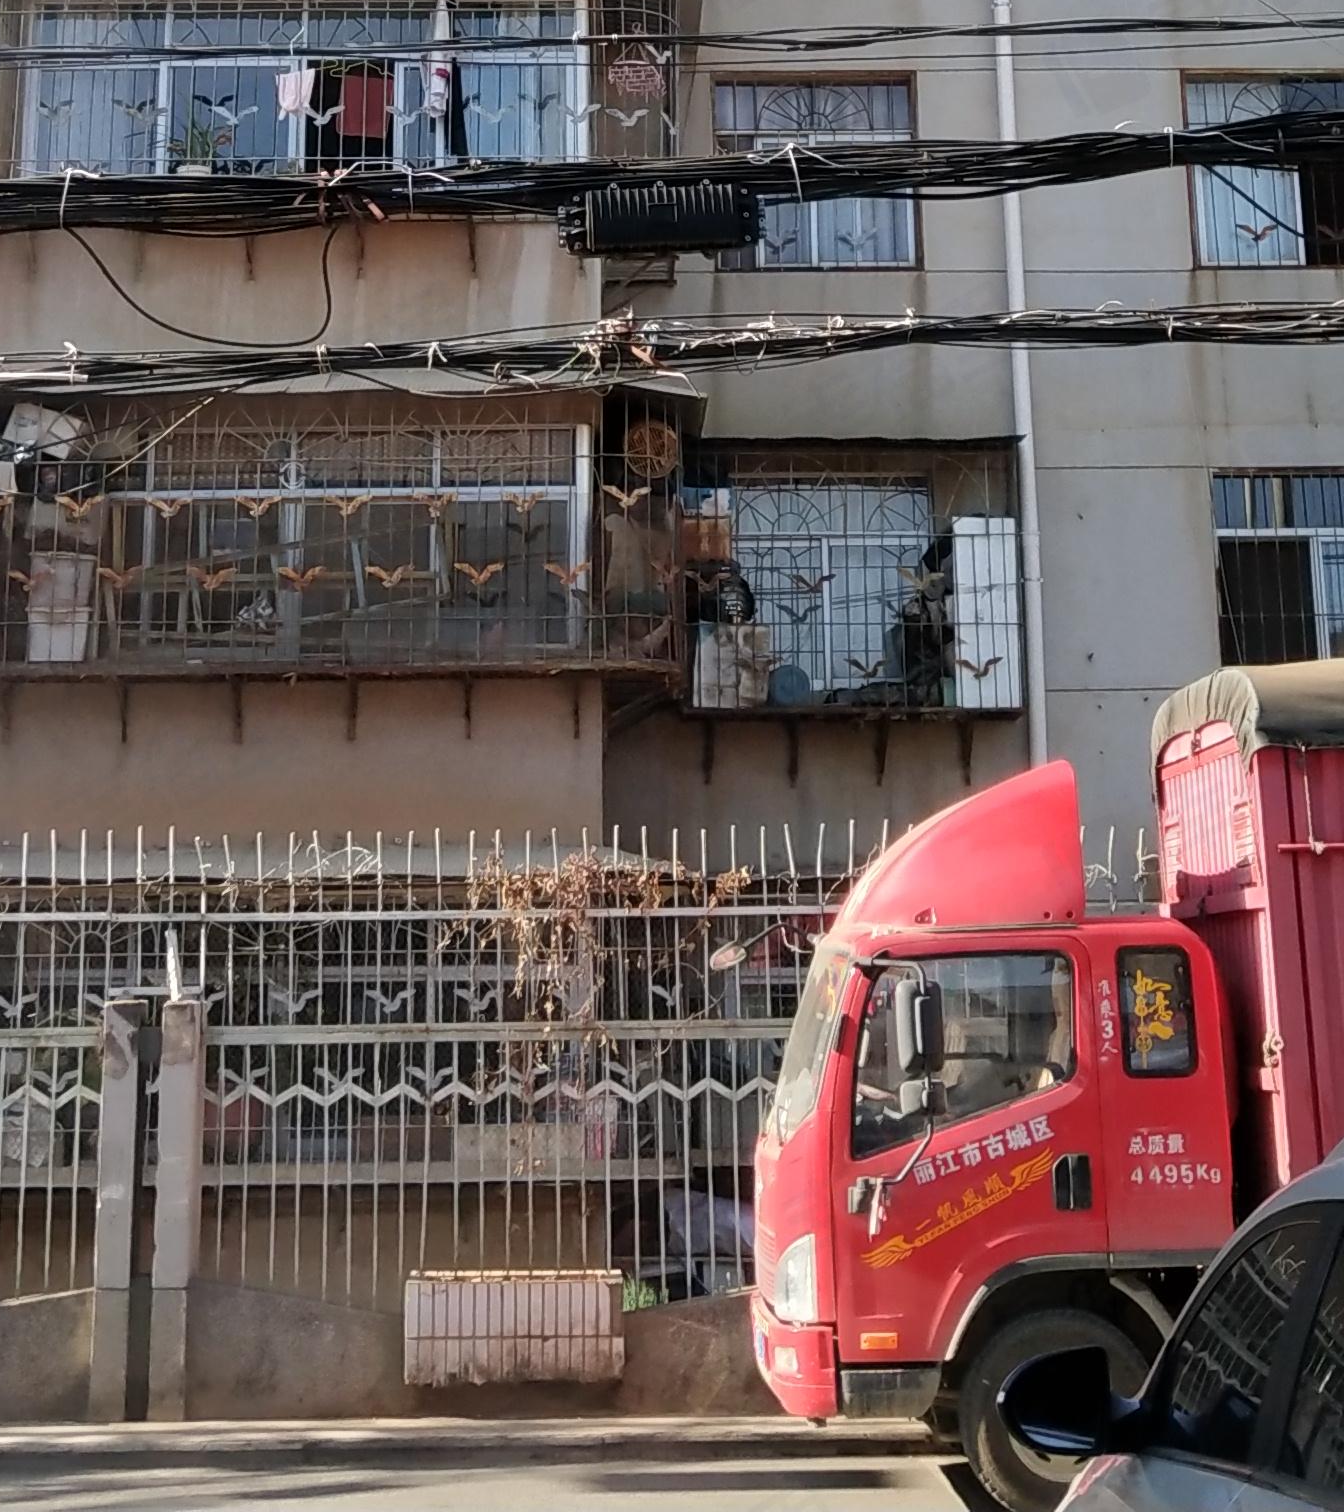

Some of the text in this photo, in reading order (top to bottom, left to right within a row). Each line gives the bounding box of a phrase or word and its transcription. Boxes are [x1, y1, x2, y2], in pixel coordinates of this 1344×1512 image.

[912, 1115, 1055, 1185] 丽江市古城区
[1128, 1133, 1185, 1155] 总质量
[1130, 1163, 1221, 1184] 4495Kg
[915, 1173, 1006, 1230] 一帆风顺
